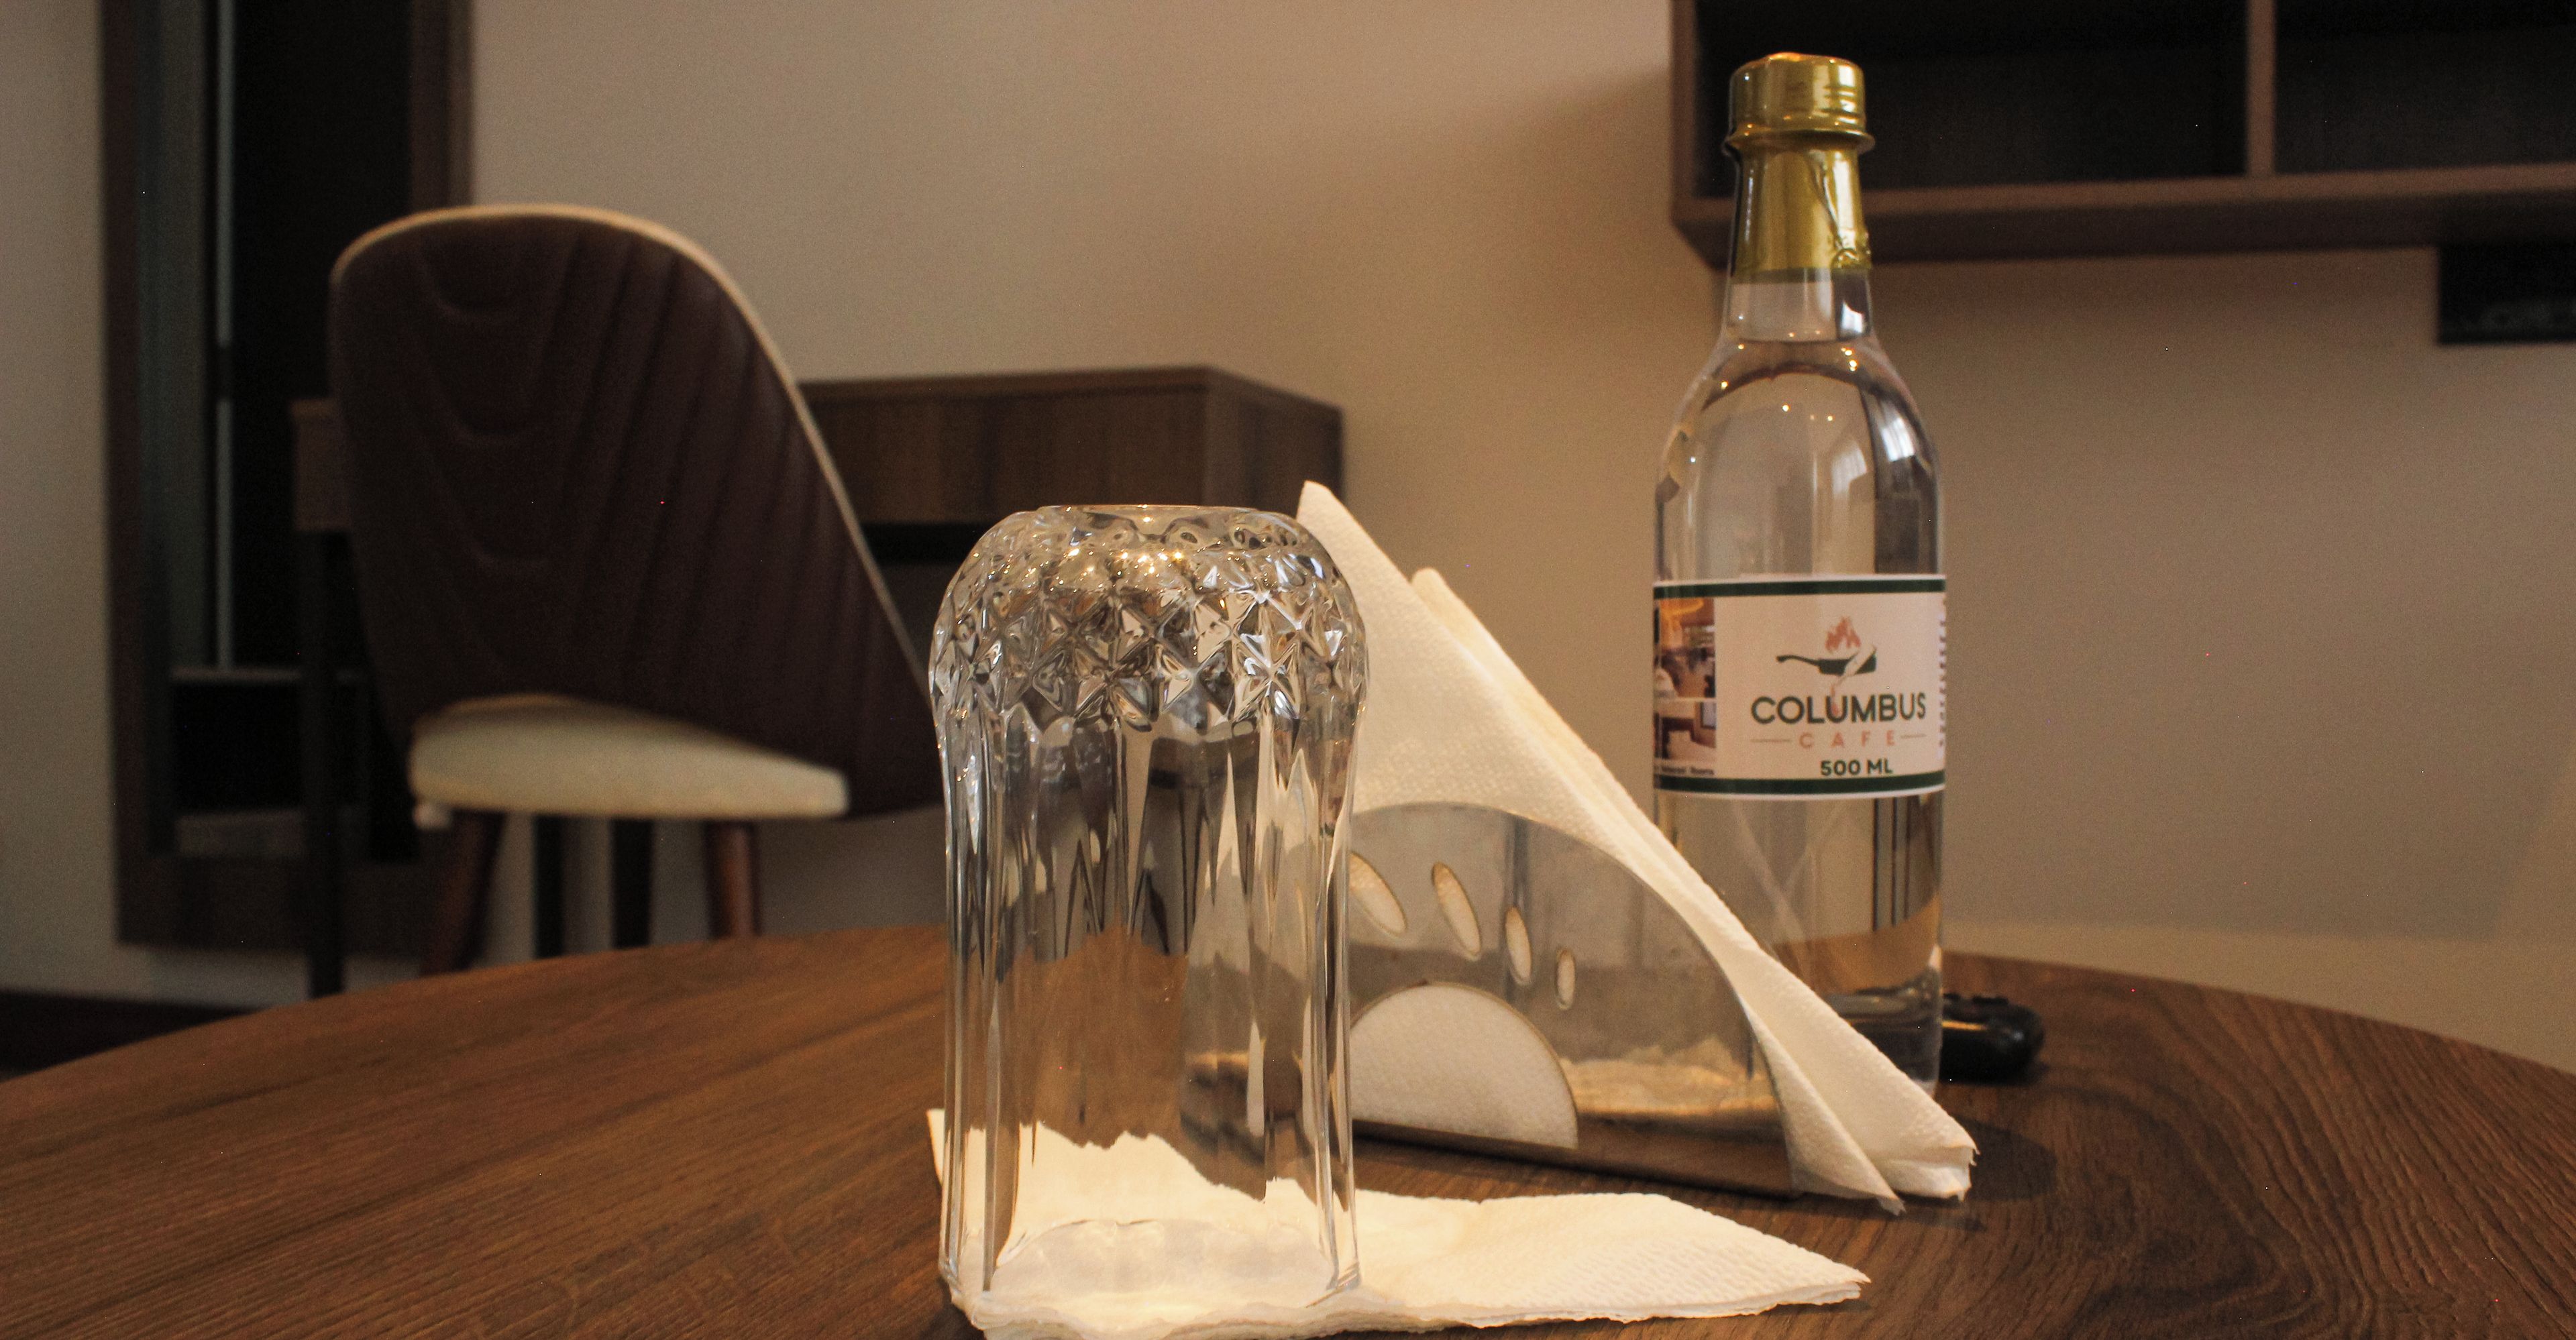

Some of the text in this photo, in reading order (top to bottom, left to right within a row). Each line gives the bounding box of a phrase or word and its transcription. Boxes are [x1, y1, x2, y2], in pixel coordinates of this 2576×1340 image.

[1751, 693, 1926, 724] COLUMBUS
[1799, 730, 1895, 749] CAFE
[1821, 759, 1894, 776] 500 ML
